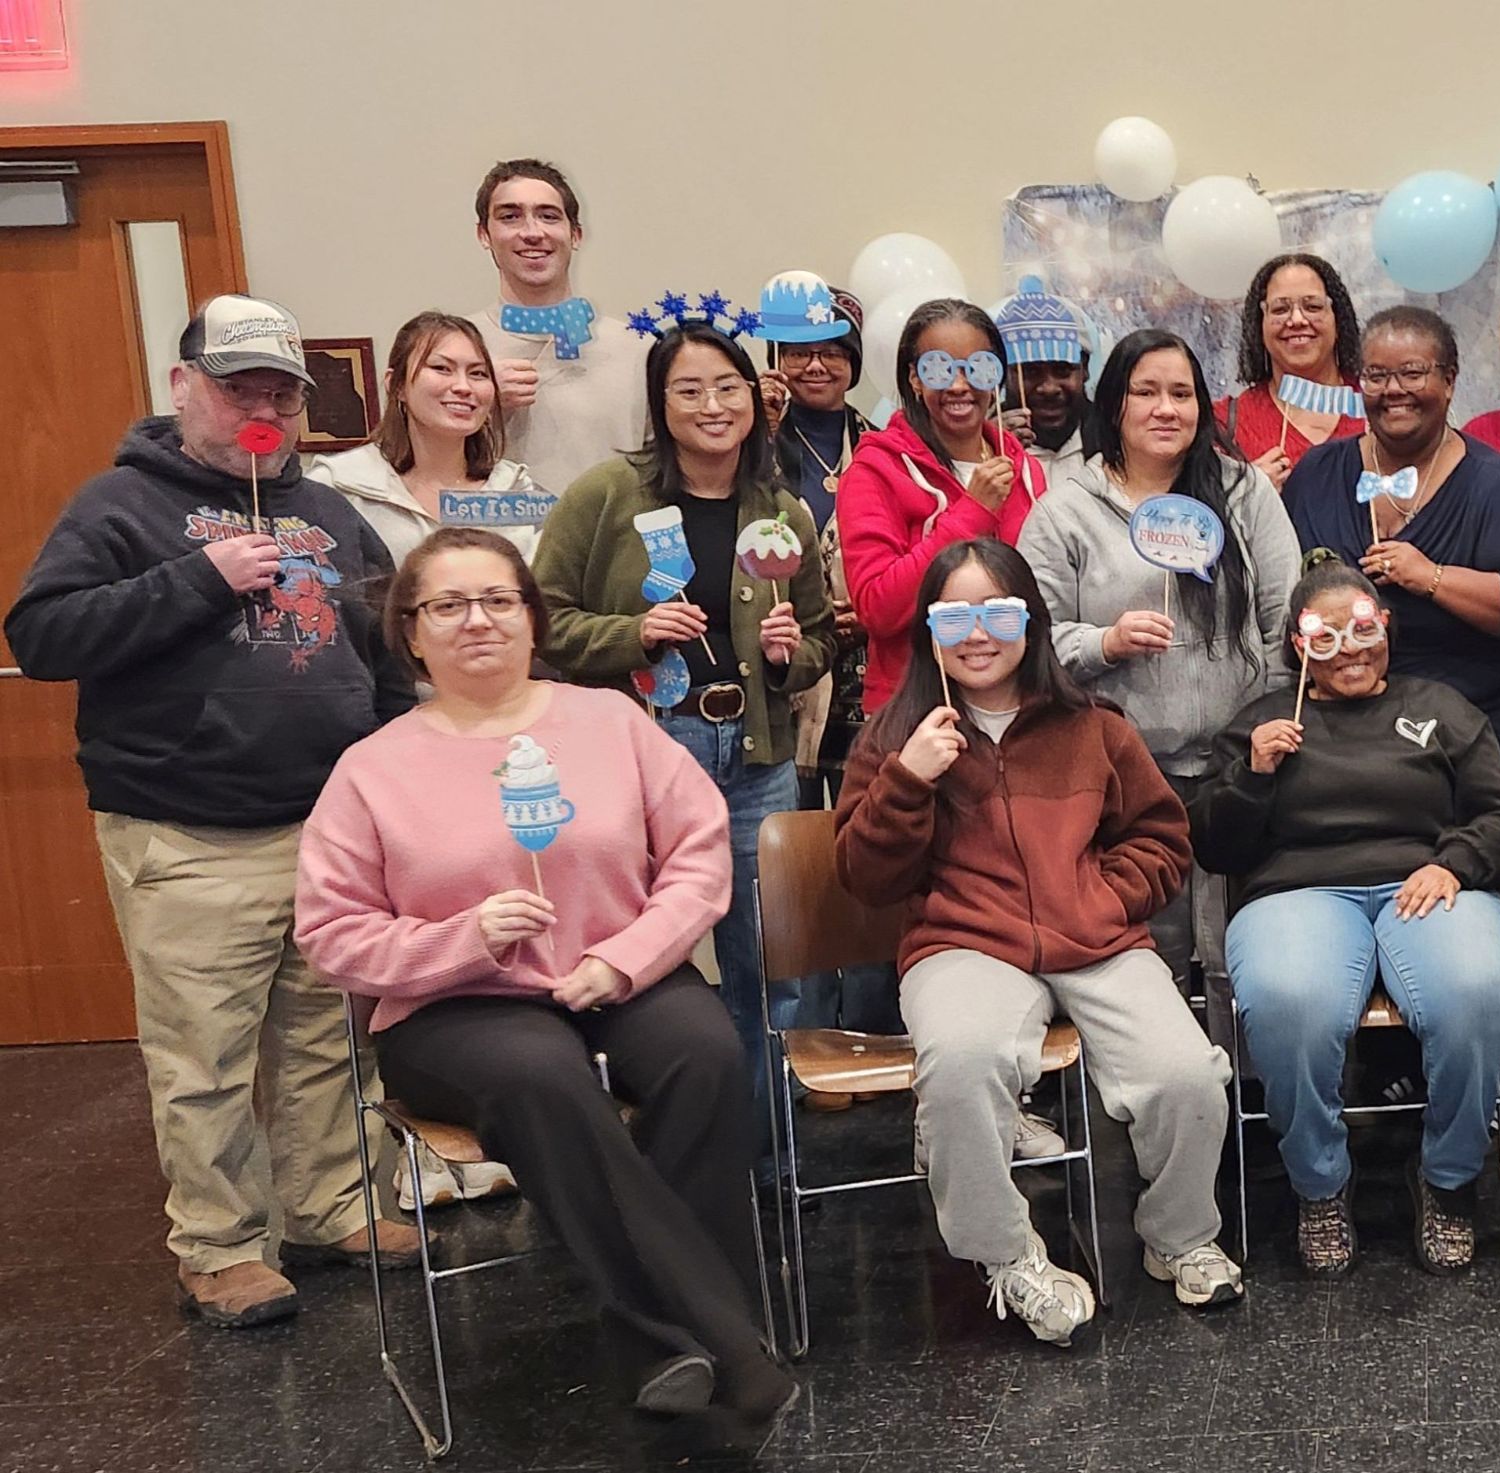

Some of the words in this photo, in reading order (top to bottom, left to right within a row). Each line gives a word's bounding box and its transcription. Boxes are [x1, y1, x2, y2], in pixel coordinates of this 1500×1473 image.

[444, 498, 482, 517] Let
[486, 498, 512, 517] It
[1138, 529, 1189, 548] FROZEN
